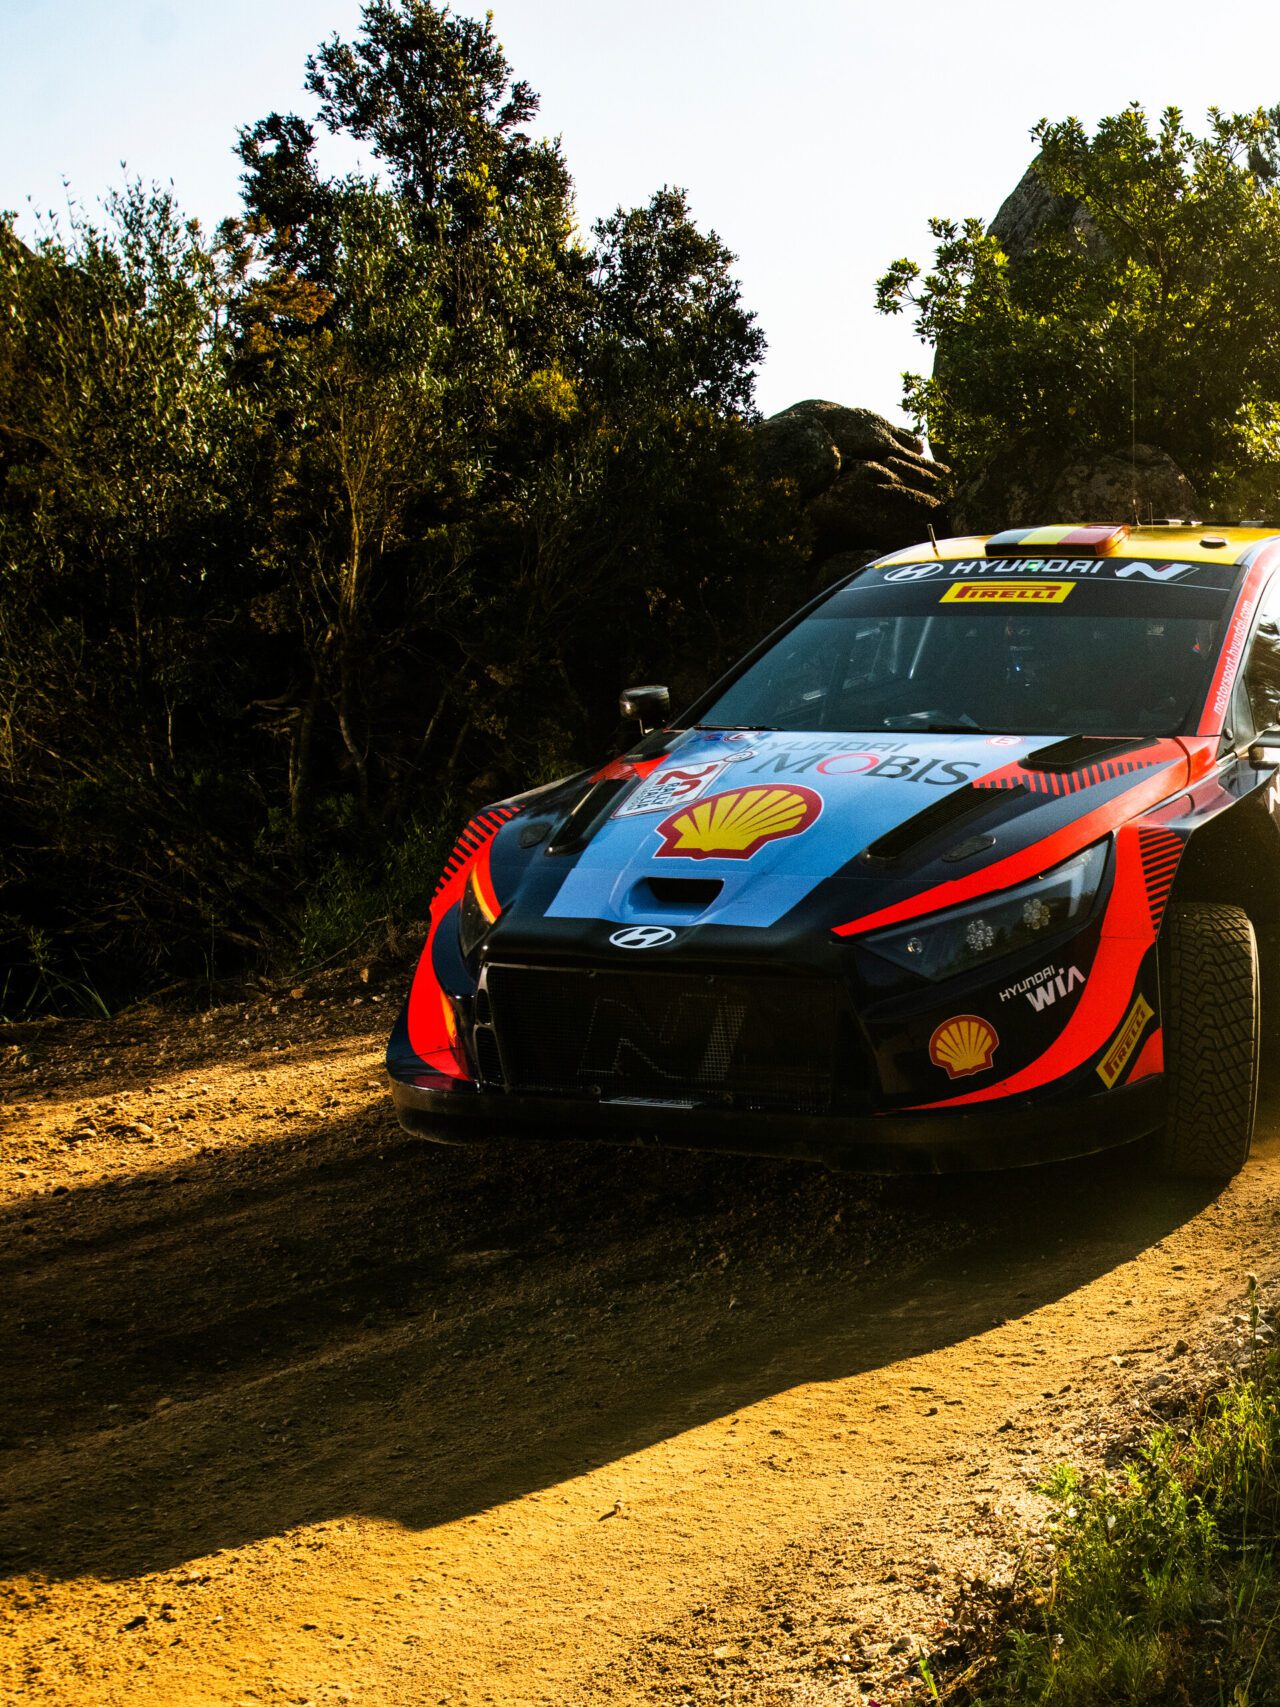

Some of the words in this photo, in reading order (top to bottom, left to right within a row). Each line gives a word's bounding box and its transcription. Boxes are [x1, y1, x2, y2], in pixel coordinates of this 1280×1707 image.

[949, 559, 1104, 575] HYUNDAI
[954, 585, 1063, 599] PIRELLI
[1213, 600, 1252, 715] motorsport.hyundai.com
[748, 753, 981, 785] MOBIS
[999, 964, 1056, 1002] HYUNDAI
[1103, 1003, 1146, 1080] PIRELLI
